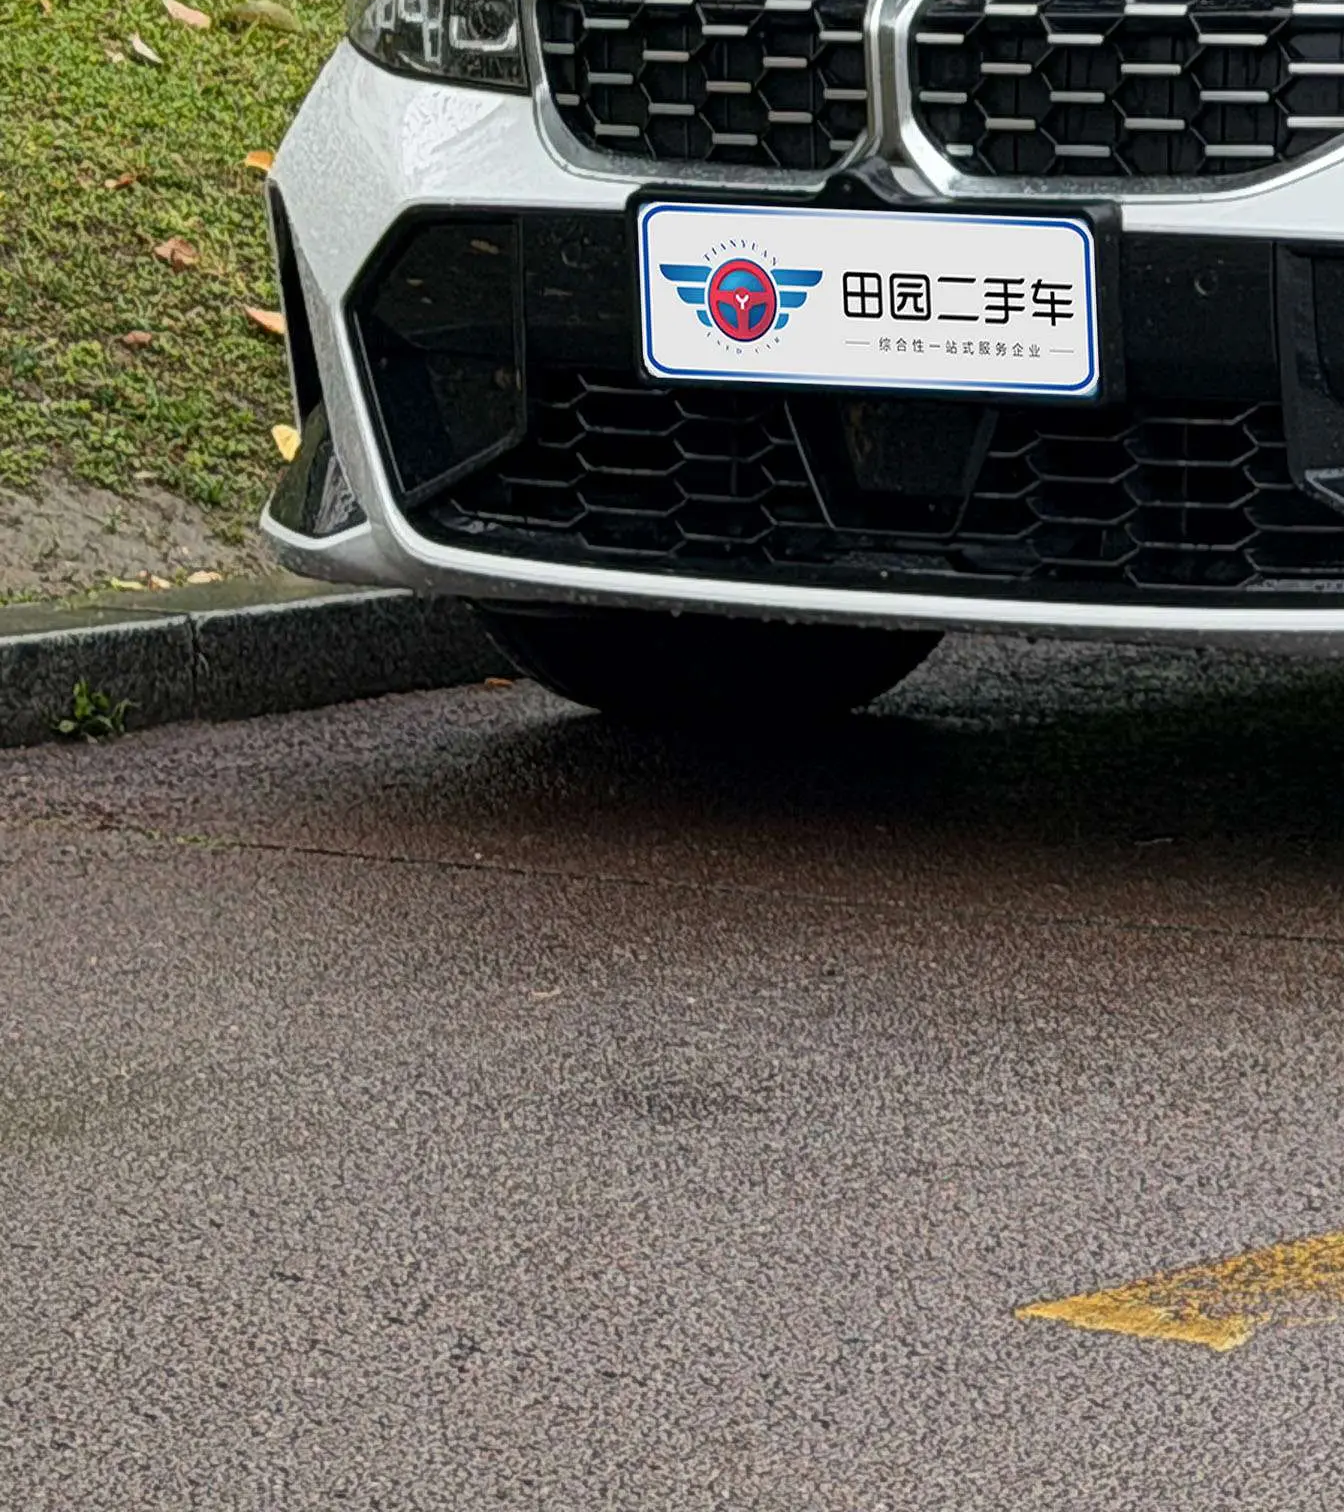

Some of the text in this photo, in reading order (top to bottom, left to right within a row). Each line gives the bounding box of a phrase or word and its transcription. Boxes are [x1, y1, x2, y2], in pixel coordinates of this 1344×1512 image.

[735, 294, 750, 310] Y
[842, 271, 1074, 327] 田园二手车
[878, 336, 1042, 358] 综合性一站式服务企业
